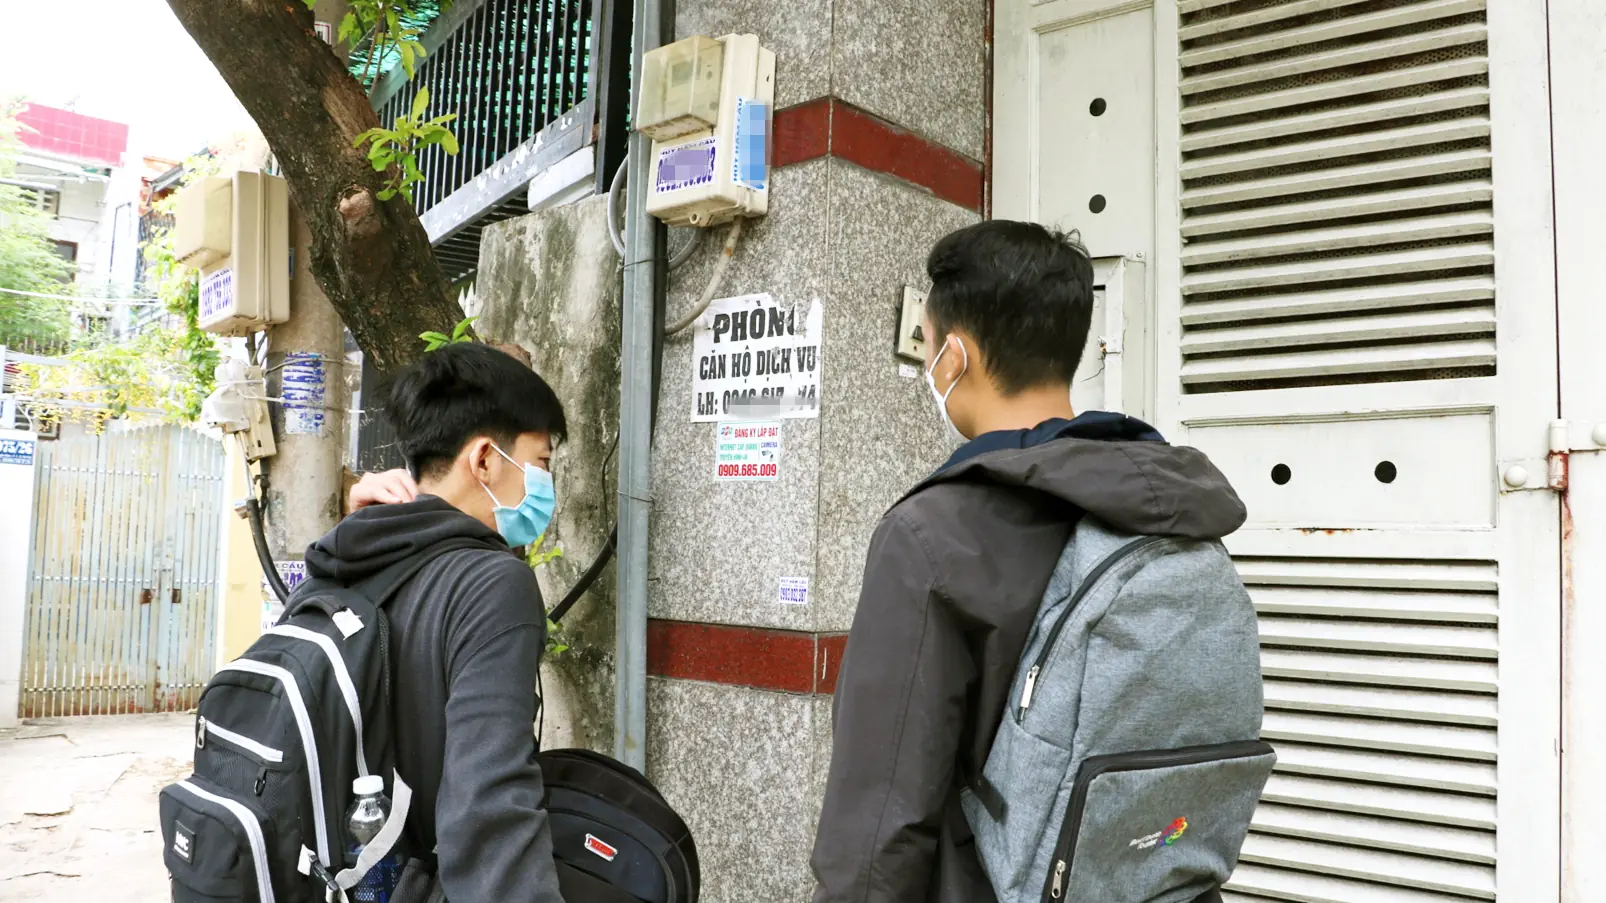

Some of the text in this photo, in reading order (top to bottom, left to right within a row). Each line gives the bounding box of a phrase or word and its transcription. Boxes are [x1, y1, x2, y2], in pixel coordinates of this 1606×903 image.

[699, 344, 817, 384] CĂN HỘ DỊCH VỤ
[696, 391, 718, 416] LH:
[718, 463, 777, 477] 0909.685.009
